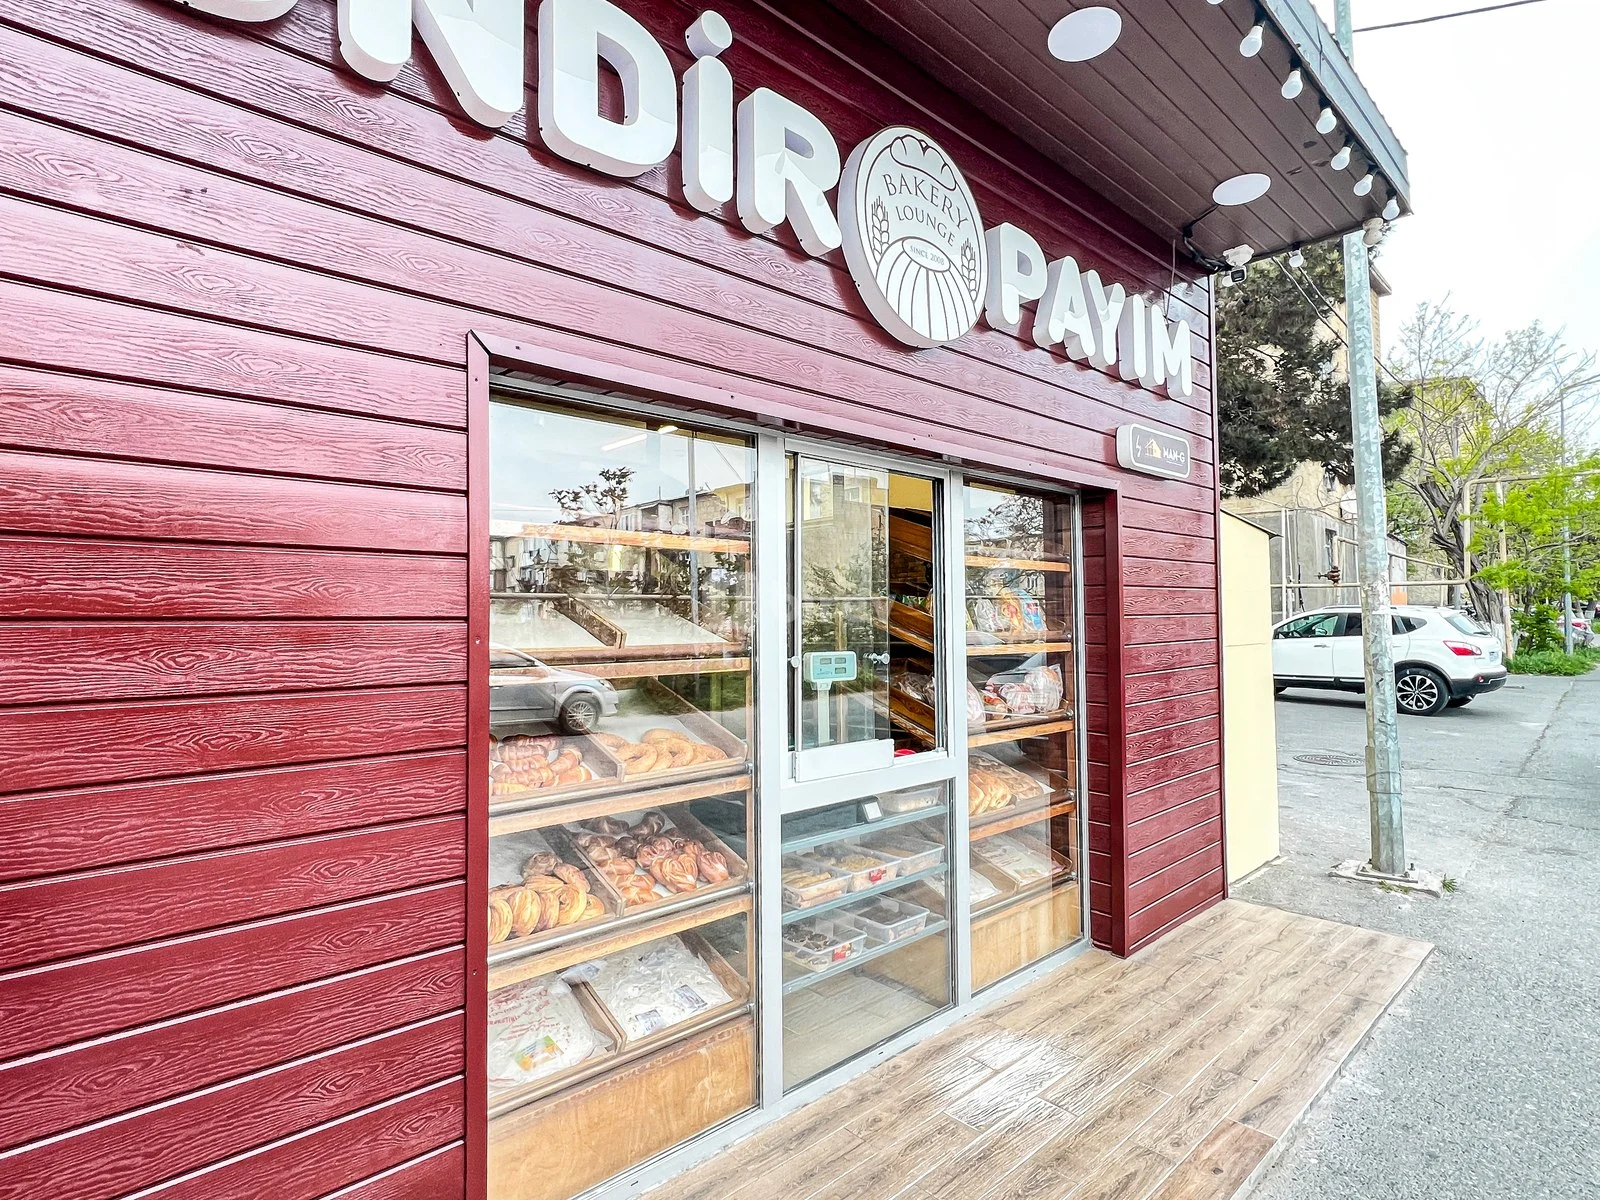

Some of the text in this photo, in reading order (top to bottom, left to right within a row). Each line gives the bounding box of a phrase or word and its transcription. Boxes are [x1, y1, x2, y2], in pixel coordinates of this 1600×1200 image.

[883, 173, 968, 229] BAKERY
[896, 205, 955, 246] LOUNGE
[985, 222, 1193, 398] PAYIM
